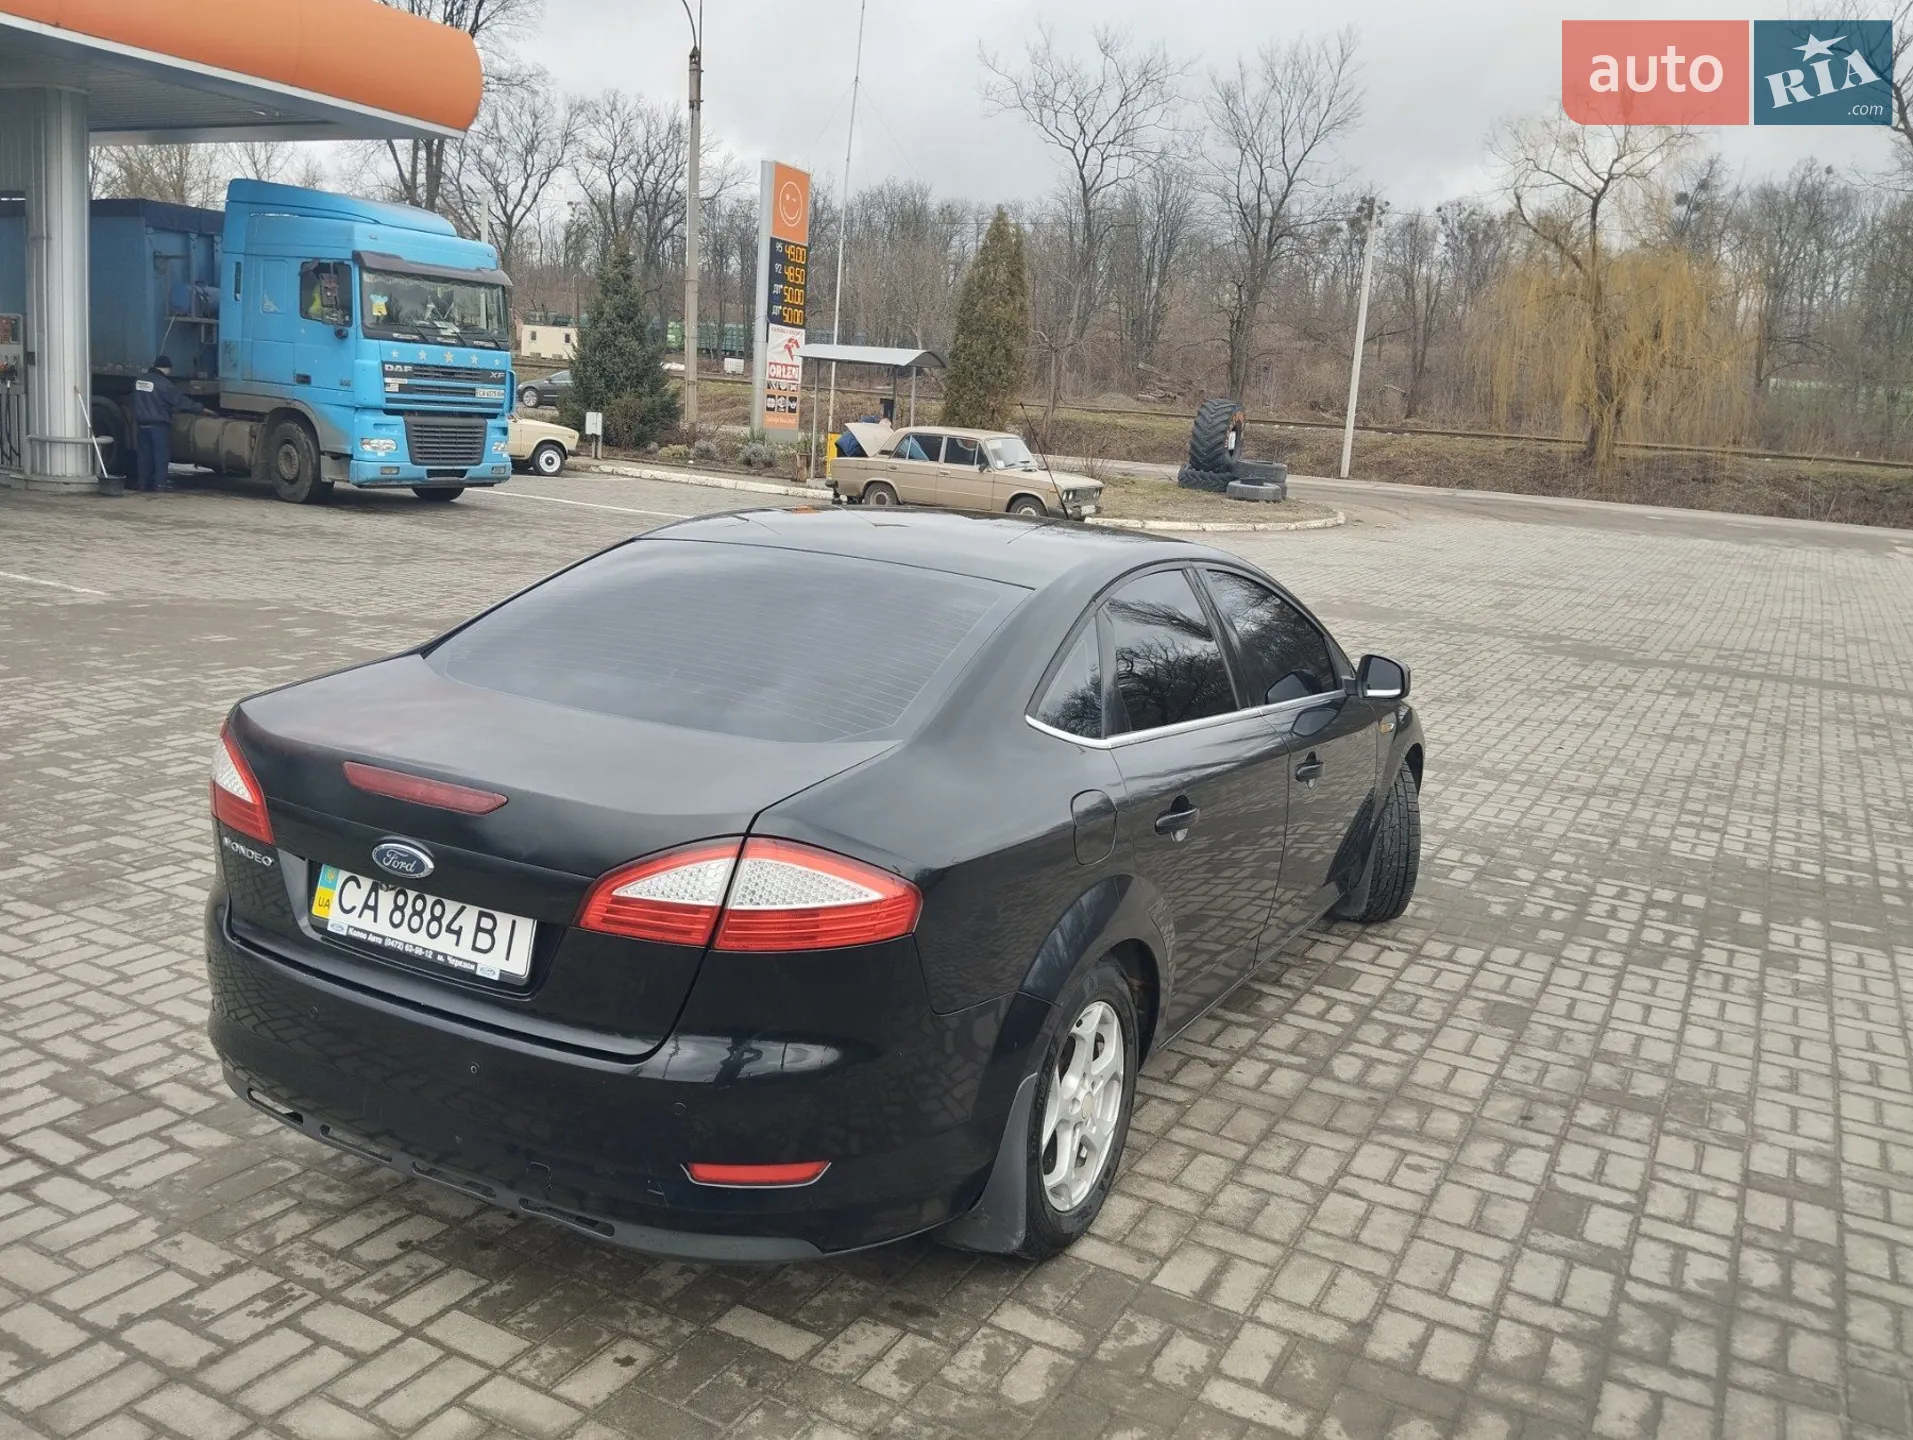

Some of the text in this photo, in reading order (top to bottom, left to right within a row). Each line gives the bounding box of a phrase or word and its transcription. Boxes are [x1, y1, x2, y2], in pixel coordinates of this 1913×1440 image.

[776, 242, 783, 252] 95
[775, 263, 782, 274] 92
[384, 364, 412, 372] DAF
[769, 363, 799, 380] ORLEN
[222, 836, 272, 866] MONDEO
[382, 850, 417, 872] Ford
[318, 898, 330, 909] UA
[338, 875, 517, 961] CA 8884 BI
[384, 936, 404, 951] (0472)
